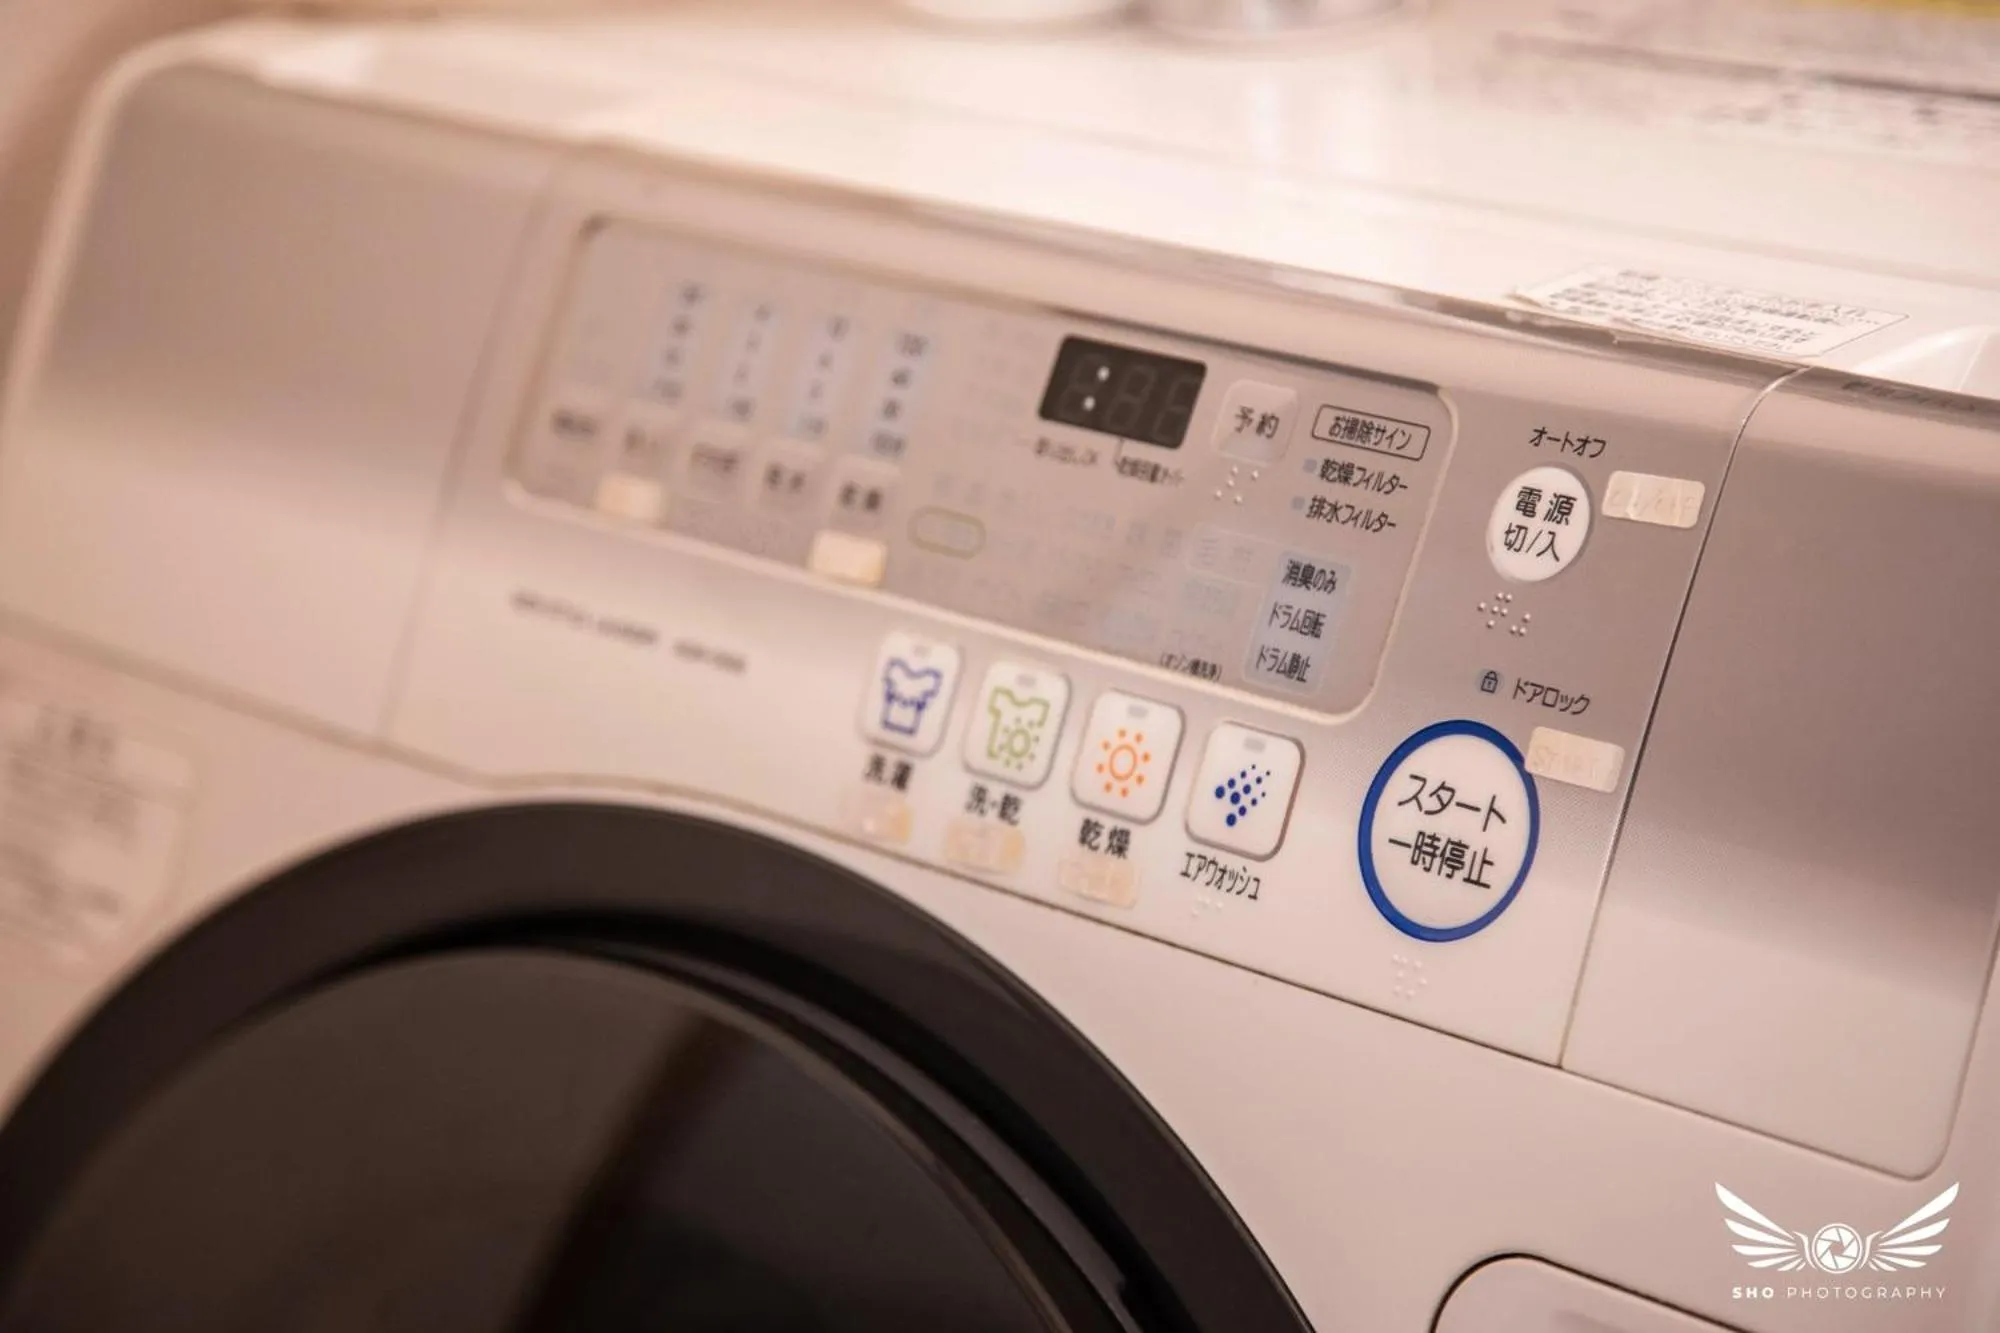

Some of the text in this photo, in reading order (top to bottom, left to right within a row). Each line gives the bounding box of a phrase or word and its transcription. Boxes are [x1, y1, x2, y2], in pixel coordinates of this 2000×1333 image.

[1235, 406, 1280, 439] 予約
[1329, 416, 1412, 450] お掃除サイン
[1529, 428, 1607, 458] オートオフ
[1320, 457, 1408, 494] 乾燥フィルター
[1306, 495, 1397, 532] 排水フィルター
[1515, 486, 1576, 526] 電源
[1504, 526, 1560, 562] 切/入
[1282, 559, 1337, 594] 消臭のみ
[1268, 601, 1327, 638] ドラム回転
[1256, 645, 1311, 682] ドラム静止
[1512, 677, 1591, 715] ドアロック
[1397, 773, 1507, 832] スタート
[1078, 817, 1132, 860] 乾燥
[1180, 851, 1261, 900] エアウォッシュ
[1388, 831, 1494, 889] 一時停止
